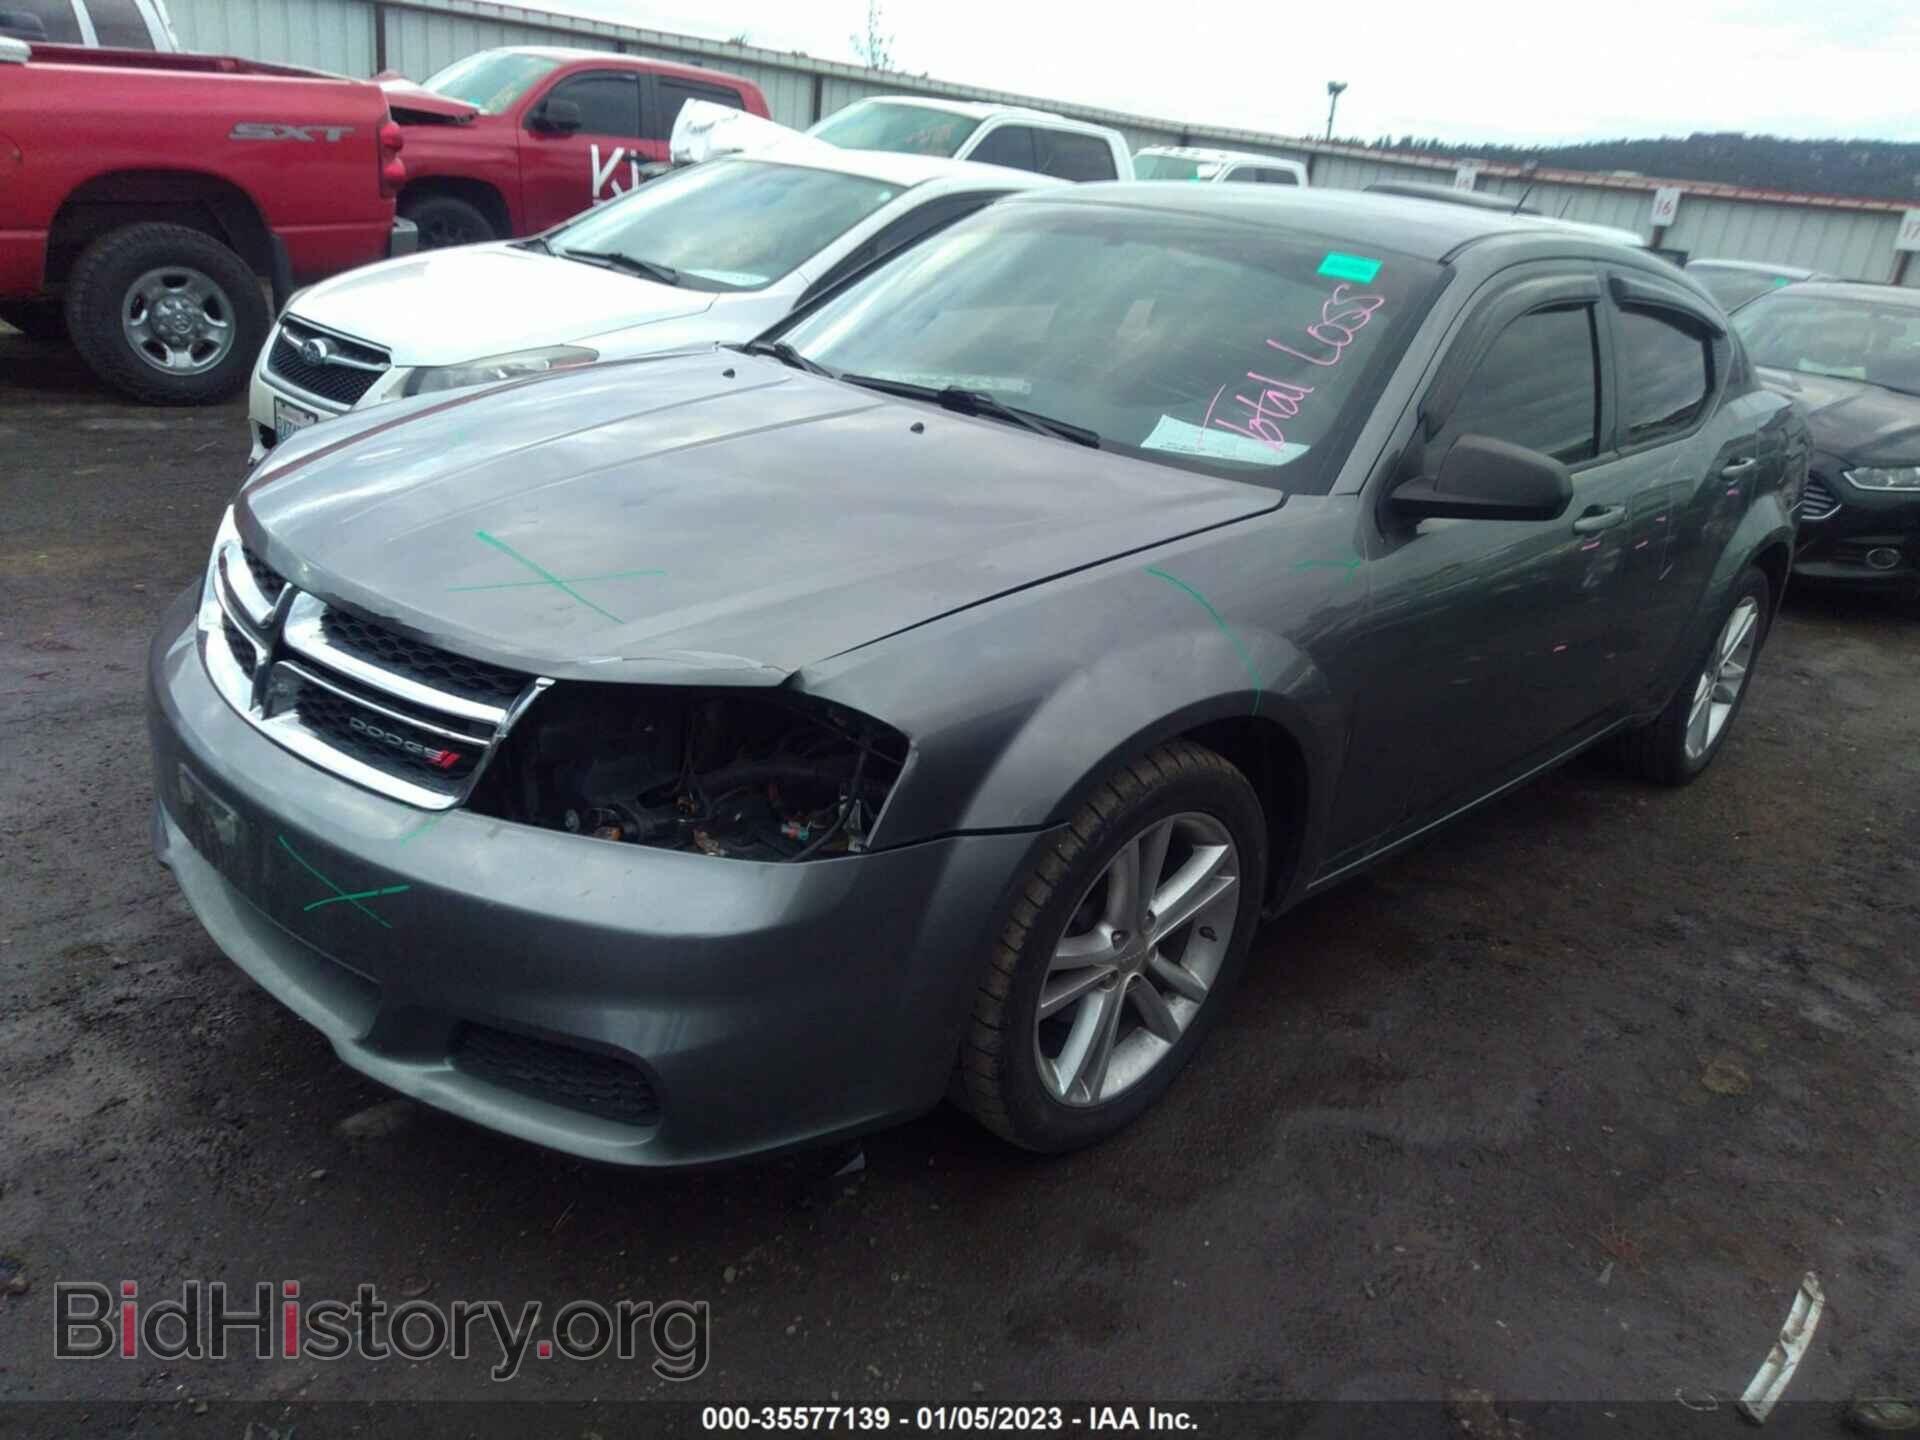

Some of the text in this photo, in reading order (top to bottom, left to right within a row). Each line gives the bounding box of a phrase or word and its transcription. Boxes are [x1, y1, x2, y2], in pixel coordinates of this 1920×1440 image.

[230, 121, 356, 142] SXT
[1656, 199, 1673, 216] 16
[350, 716, 443, 762] DODGE
